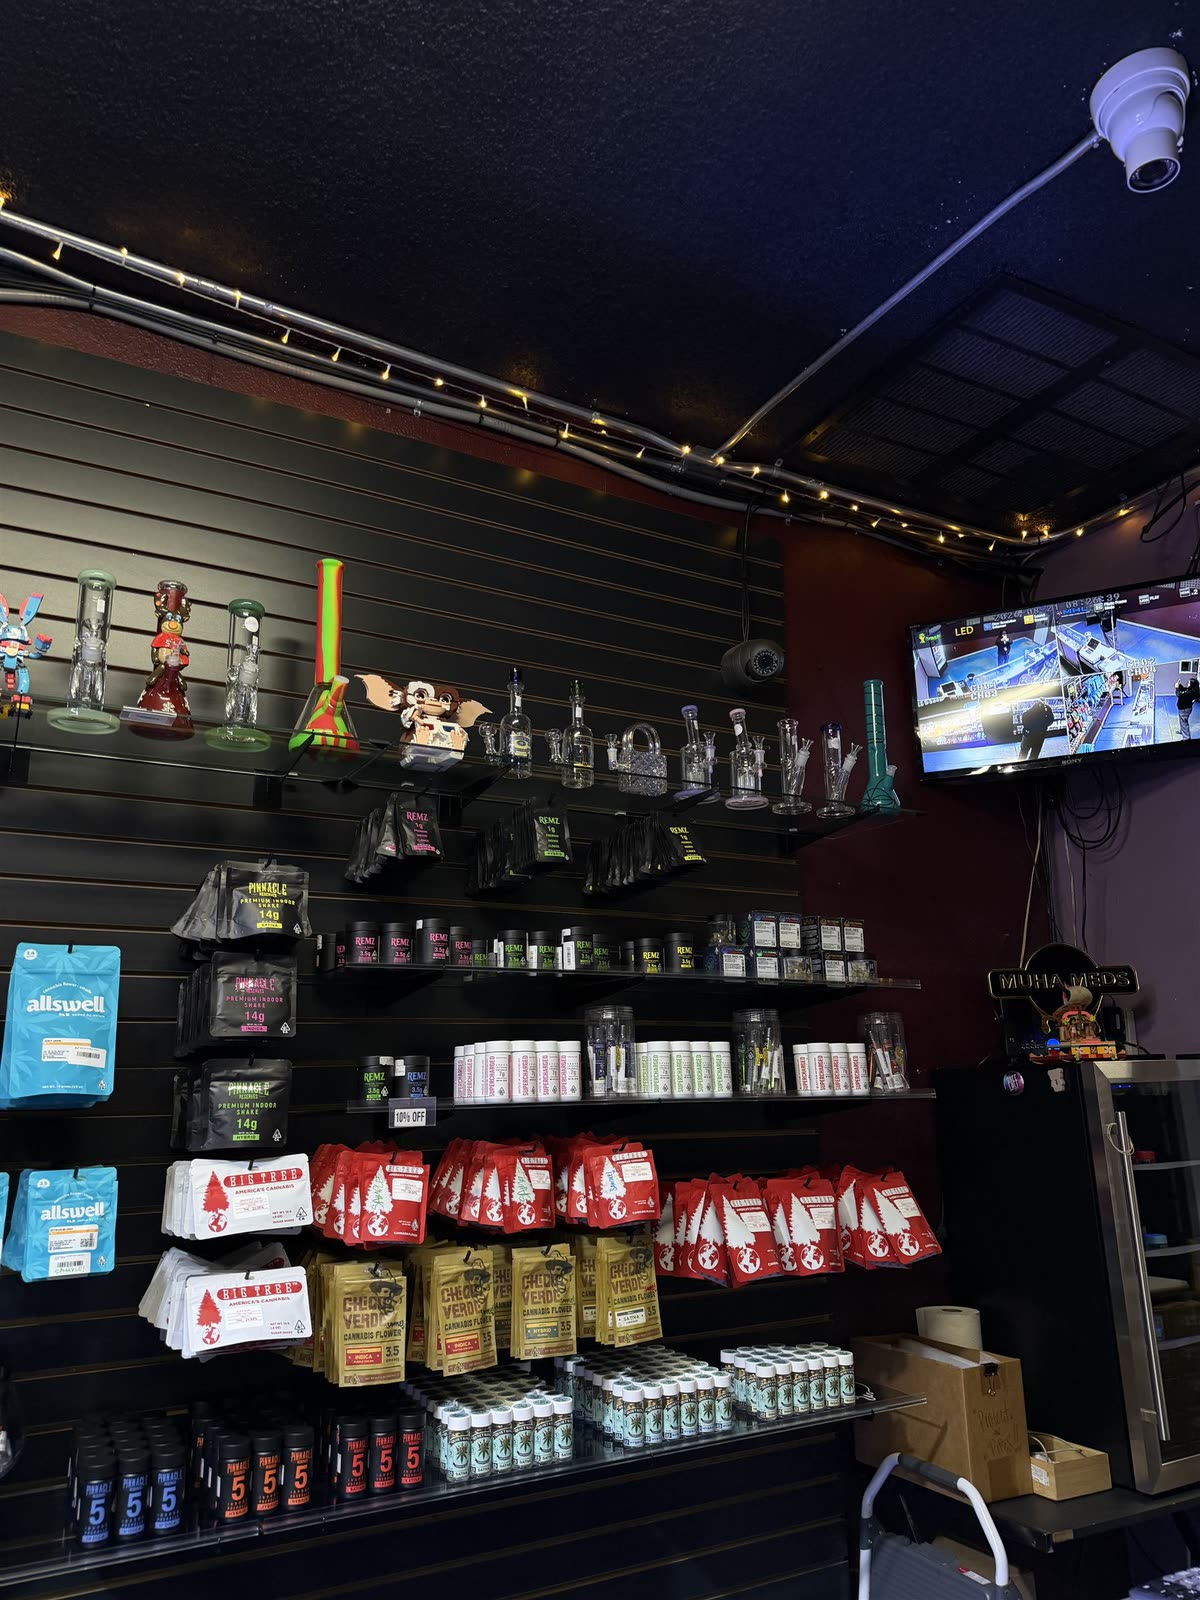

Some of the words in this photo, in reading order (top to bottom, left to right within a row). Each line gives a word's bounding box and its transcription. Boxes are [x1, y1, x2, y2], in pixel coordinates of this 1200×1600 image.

[954, 626, 974, 637] LED
[1062, 758, 1082, 766] SONY
[406, 811, 429, 822] REMZ
[538, 816, 560, 825] REMZ
[669, 826, 690, 834] REMZ
[248, 882, 288, 896] PINNACLE
[260, 910, 280, 921] 14g
[354, 936, 376, 946] REMZ
[390, 937, 410, 947] REMZ
[429, 932, 448, 942] REMZ
[455, 940, 472, 950] REMZ
[505, 944, 524, 954] REMZ
[539, 944, 555, 954] REMZ
[576, 940, 592, 950] REMZ
[677, 946, 693, 955] REMZ
[594, 947, 609, 956] REMZ
[642, 951, 660, 960] REMZ
[998, 974, 1064, 990] MUHA
[1070, 971, 1131, 988] MEDS
[26, 995, 105, 1013] allswell
[245, 1011, 265, 1023] 14g
[364, 1072, 386, 1082] REMZ
[407, 1072, 426, 1082] REMZ
[228, 1082, 271, 1096] PINNACLE
[396, 1112, 410, 1122] 10%
[412, 1111, 426, 1122] OFF
[236, 1118, 258, 1132] 14g
[230, 1174, 254, 1187] BIG
[260, 1168, 298, 1183] TREE
[235, 1187, 264, 1195] AMERICA'S
[266, 1184, 294, 1192] CANNABIS
[40, 1202, 105, 1221] allswell
[222, 1288, 247, 1301] BIG
[254, 1282, 292, 1297] TREE
[614, 1295, 638, 1305] CANNABIS
[638, 1292, 656, 1302] FLOWER
[522, 1308, 550, 1317] CANNABIS
[551, 1306, 572, 1314] FLOWER
[444, 1319, 472, 1331] CANNABIS
[560, 1321, 571, 1332] 3.5
[344, 1332, 374, 1341] CANNABIS
[376, 1330, 402, 1340] FLOWER
[386, 1345, 400, 1358] 3.5
[380, 1448, 392, 1472] 5
[407, 1446, 420, 1470] 5
[352, 1452, 364, 1478] 5
[122, 1474, 148, 1489] PINNACLE
[158, 1469, 183, 1485] PINNACLE
[264, 1468, 277, 1494] 5
[294, 1464, 308, 1490] 5
[86, 1481, 112, 1496] PINNACLE
[232, 1475, 246, 1502] 5
[126, 1490, 142, 1519] 5
[162, 1485, 177, 1513] 5
[89, 1497, 106, 1526] 5
